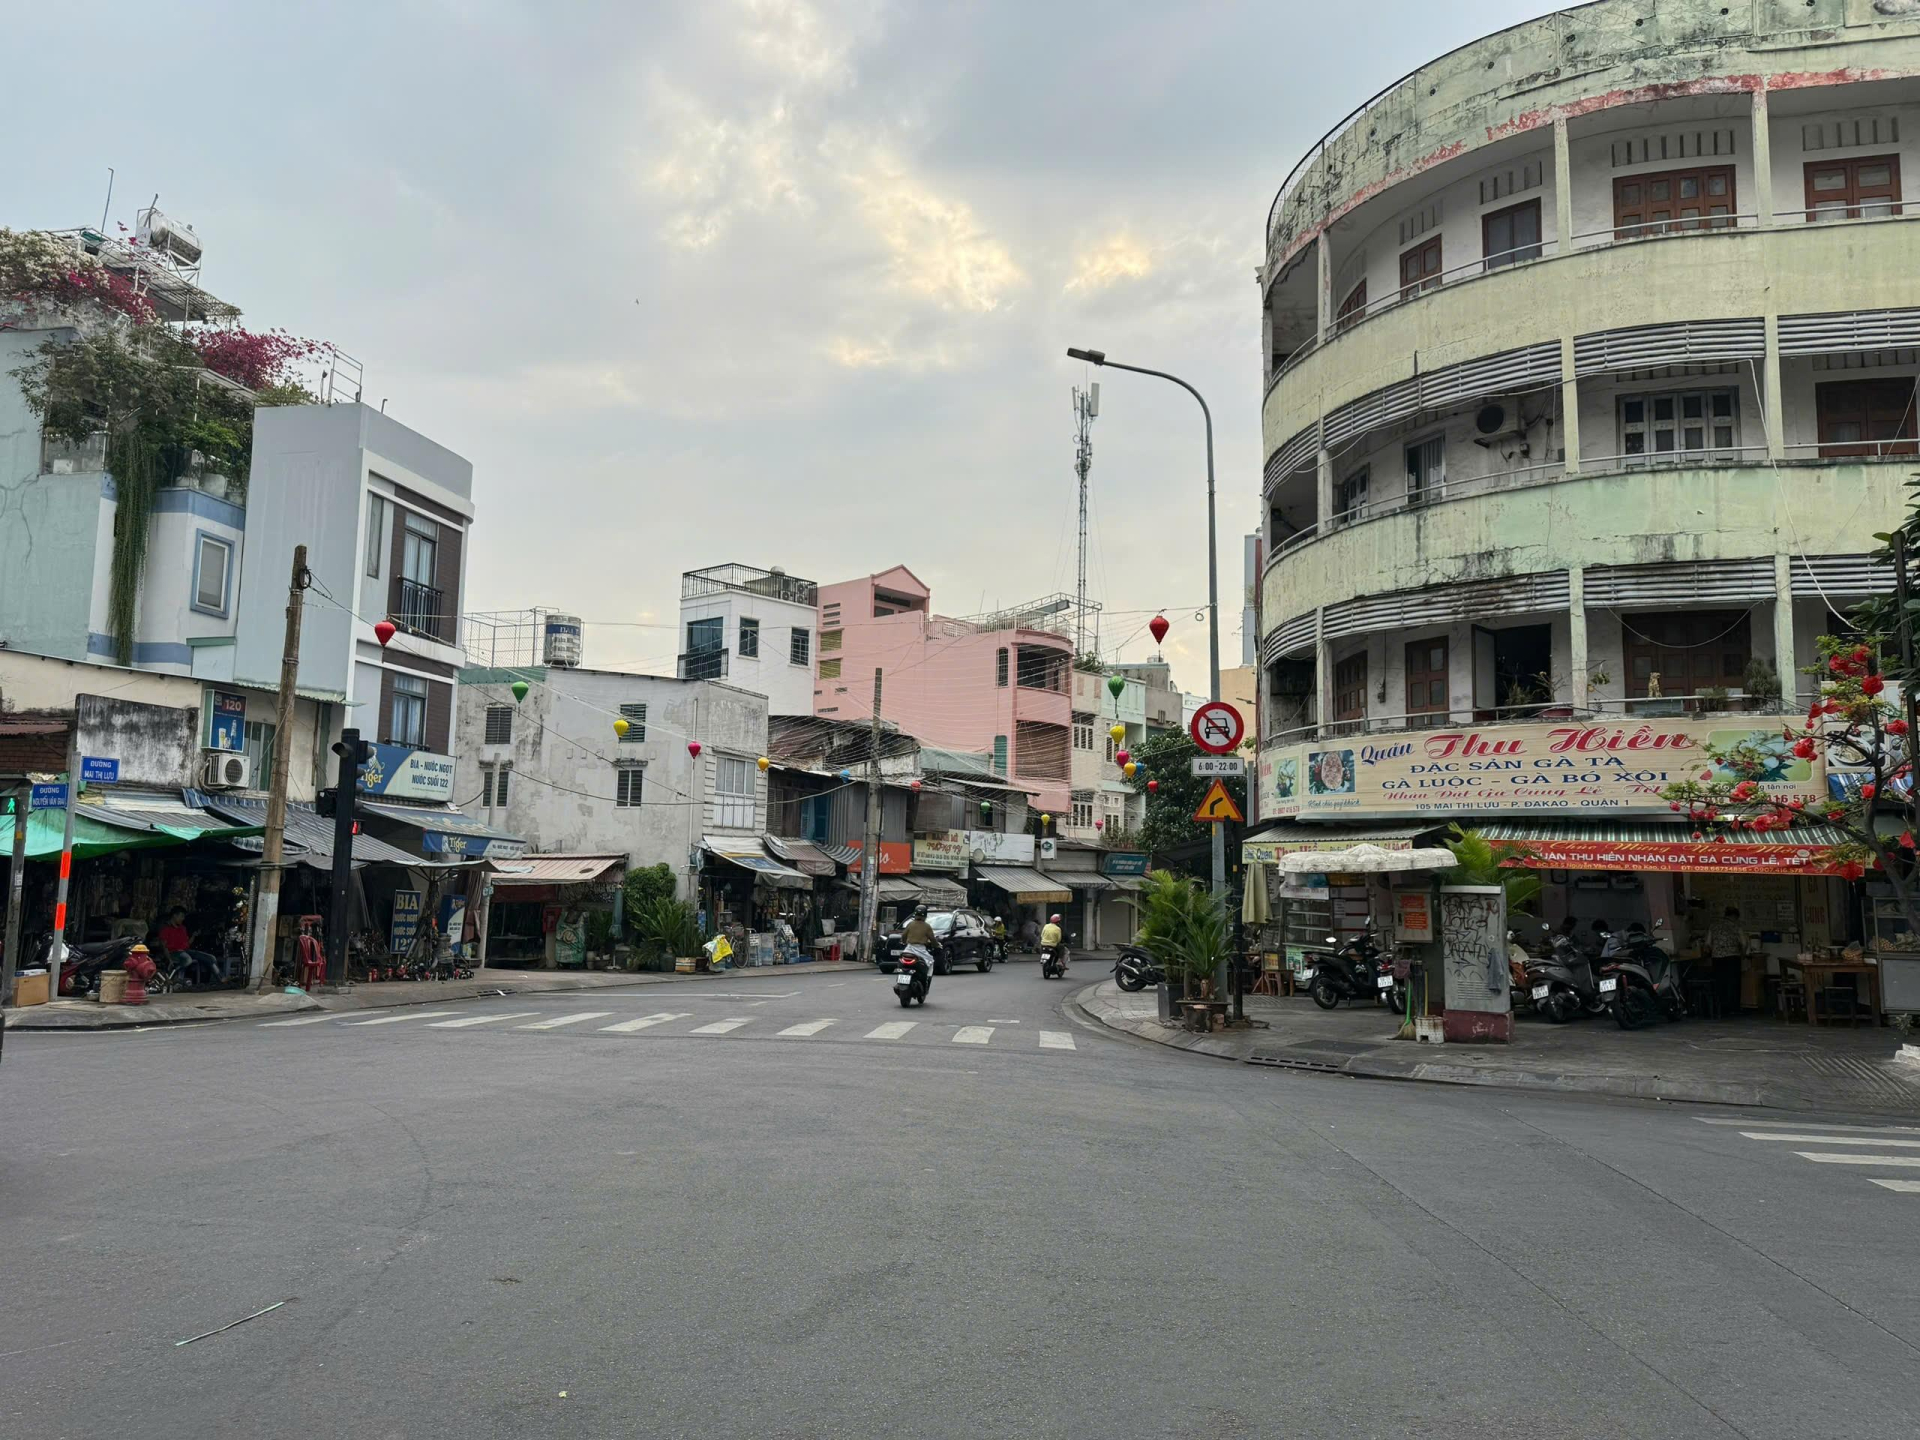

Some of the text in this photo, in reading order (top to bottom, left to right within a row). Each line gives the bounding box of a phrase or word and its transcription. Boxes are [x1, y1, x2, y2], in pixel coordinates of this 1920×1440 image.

[225, 699, 242, 711] 120
[1361, 725, 1694, 766] Quán Thu Hiền
[410, 759, 420, 769] BIA
[1410, 756, 1625, 774] ĐẶC SẢN GÀ TA
[84, 770, 94, 778] MAI
[1382, 769, 1669, 789] GÀ LUỘC GÀ BÓ XÔI
[439, 778, 449, 788] 122
[1456, 802, 1473, 810] THỊ
[1524, 800, 1568, 808] ĐAKAO
[1580, 798, 1619, 808] QUẬN
[449, 835, 467, 853] Tiger
[1569, 853, 1593, 861] THU
[1596, 851, 1625, 861] HIỀN
[1628, 853, 1665, 864] NHẬN
[1668, 854, 1695, 865] ĐẶT
[1699, 854, 1718, 863] GÀ
[1721, 854, 1758, 864] CÚNG
[396, 894, 418, 910] BIA
